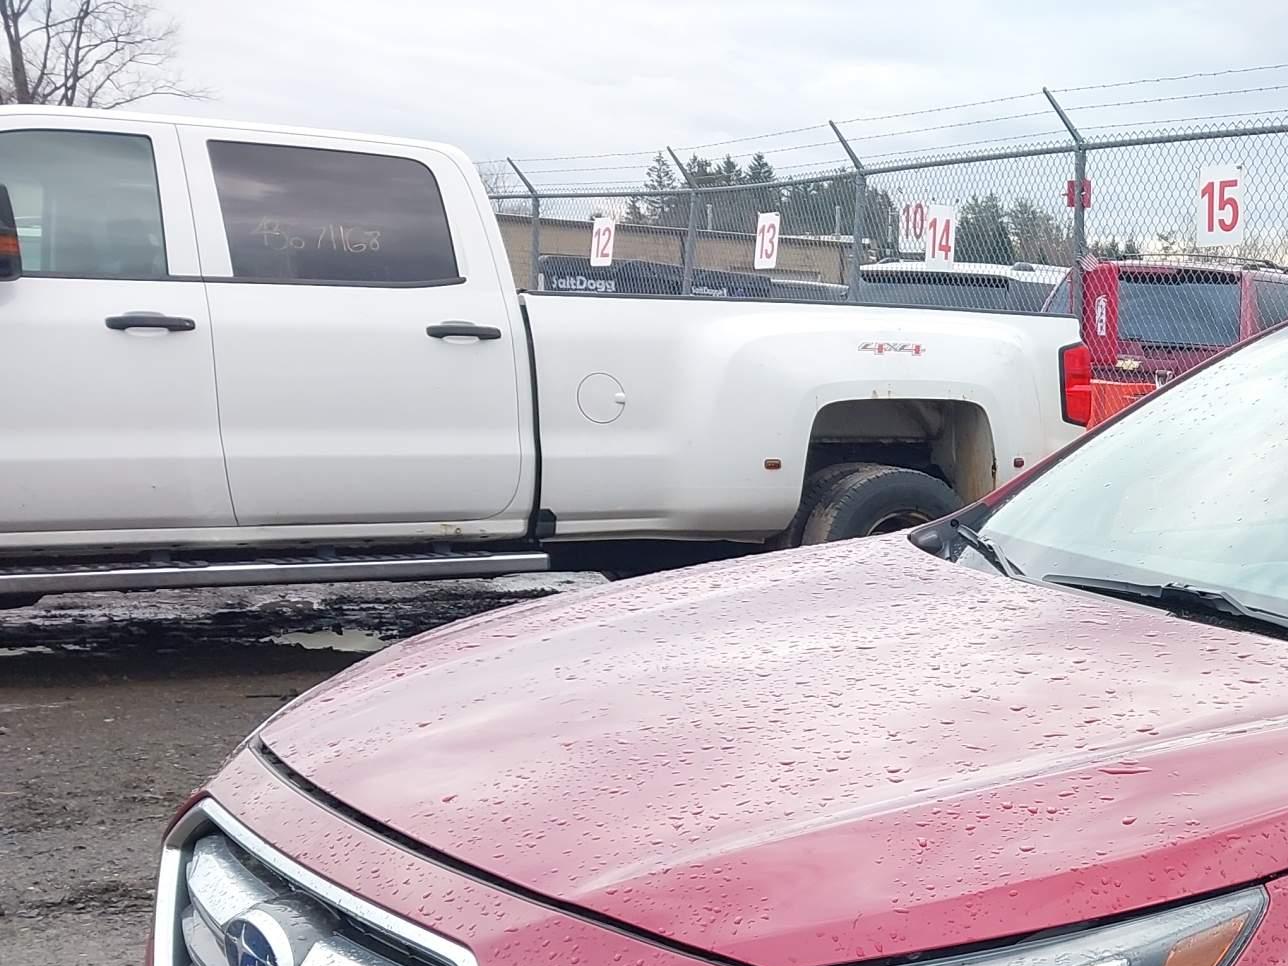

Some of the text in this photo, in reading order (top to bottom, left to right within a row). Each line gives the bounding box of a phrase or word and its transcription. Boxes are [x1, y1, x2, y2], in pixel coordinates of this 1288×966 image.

[902, 203, 924, 240] 10
[1200, 179, 1240, 233] 15
[594, 226, 613, 258] 12
[757, 223, 776, 260] 13
[928, 217, 952, 261] 14
